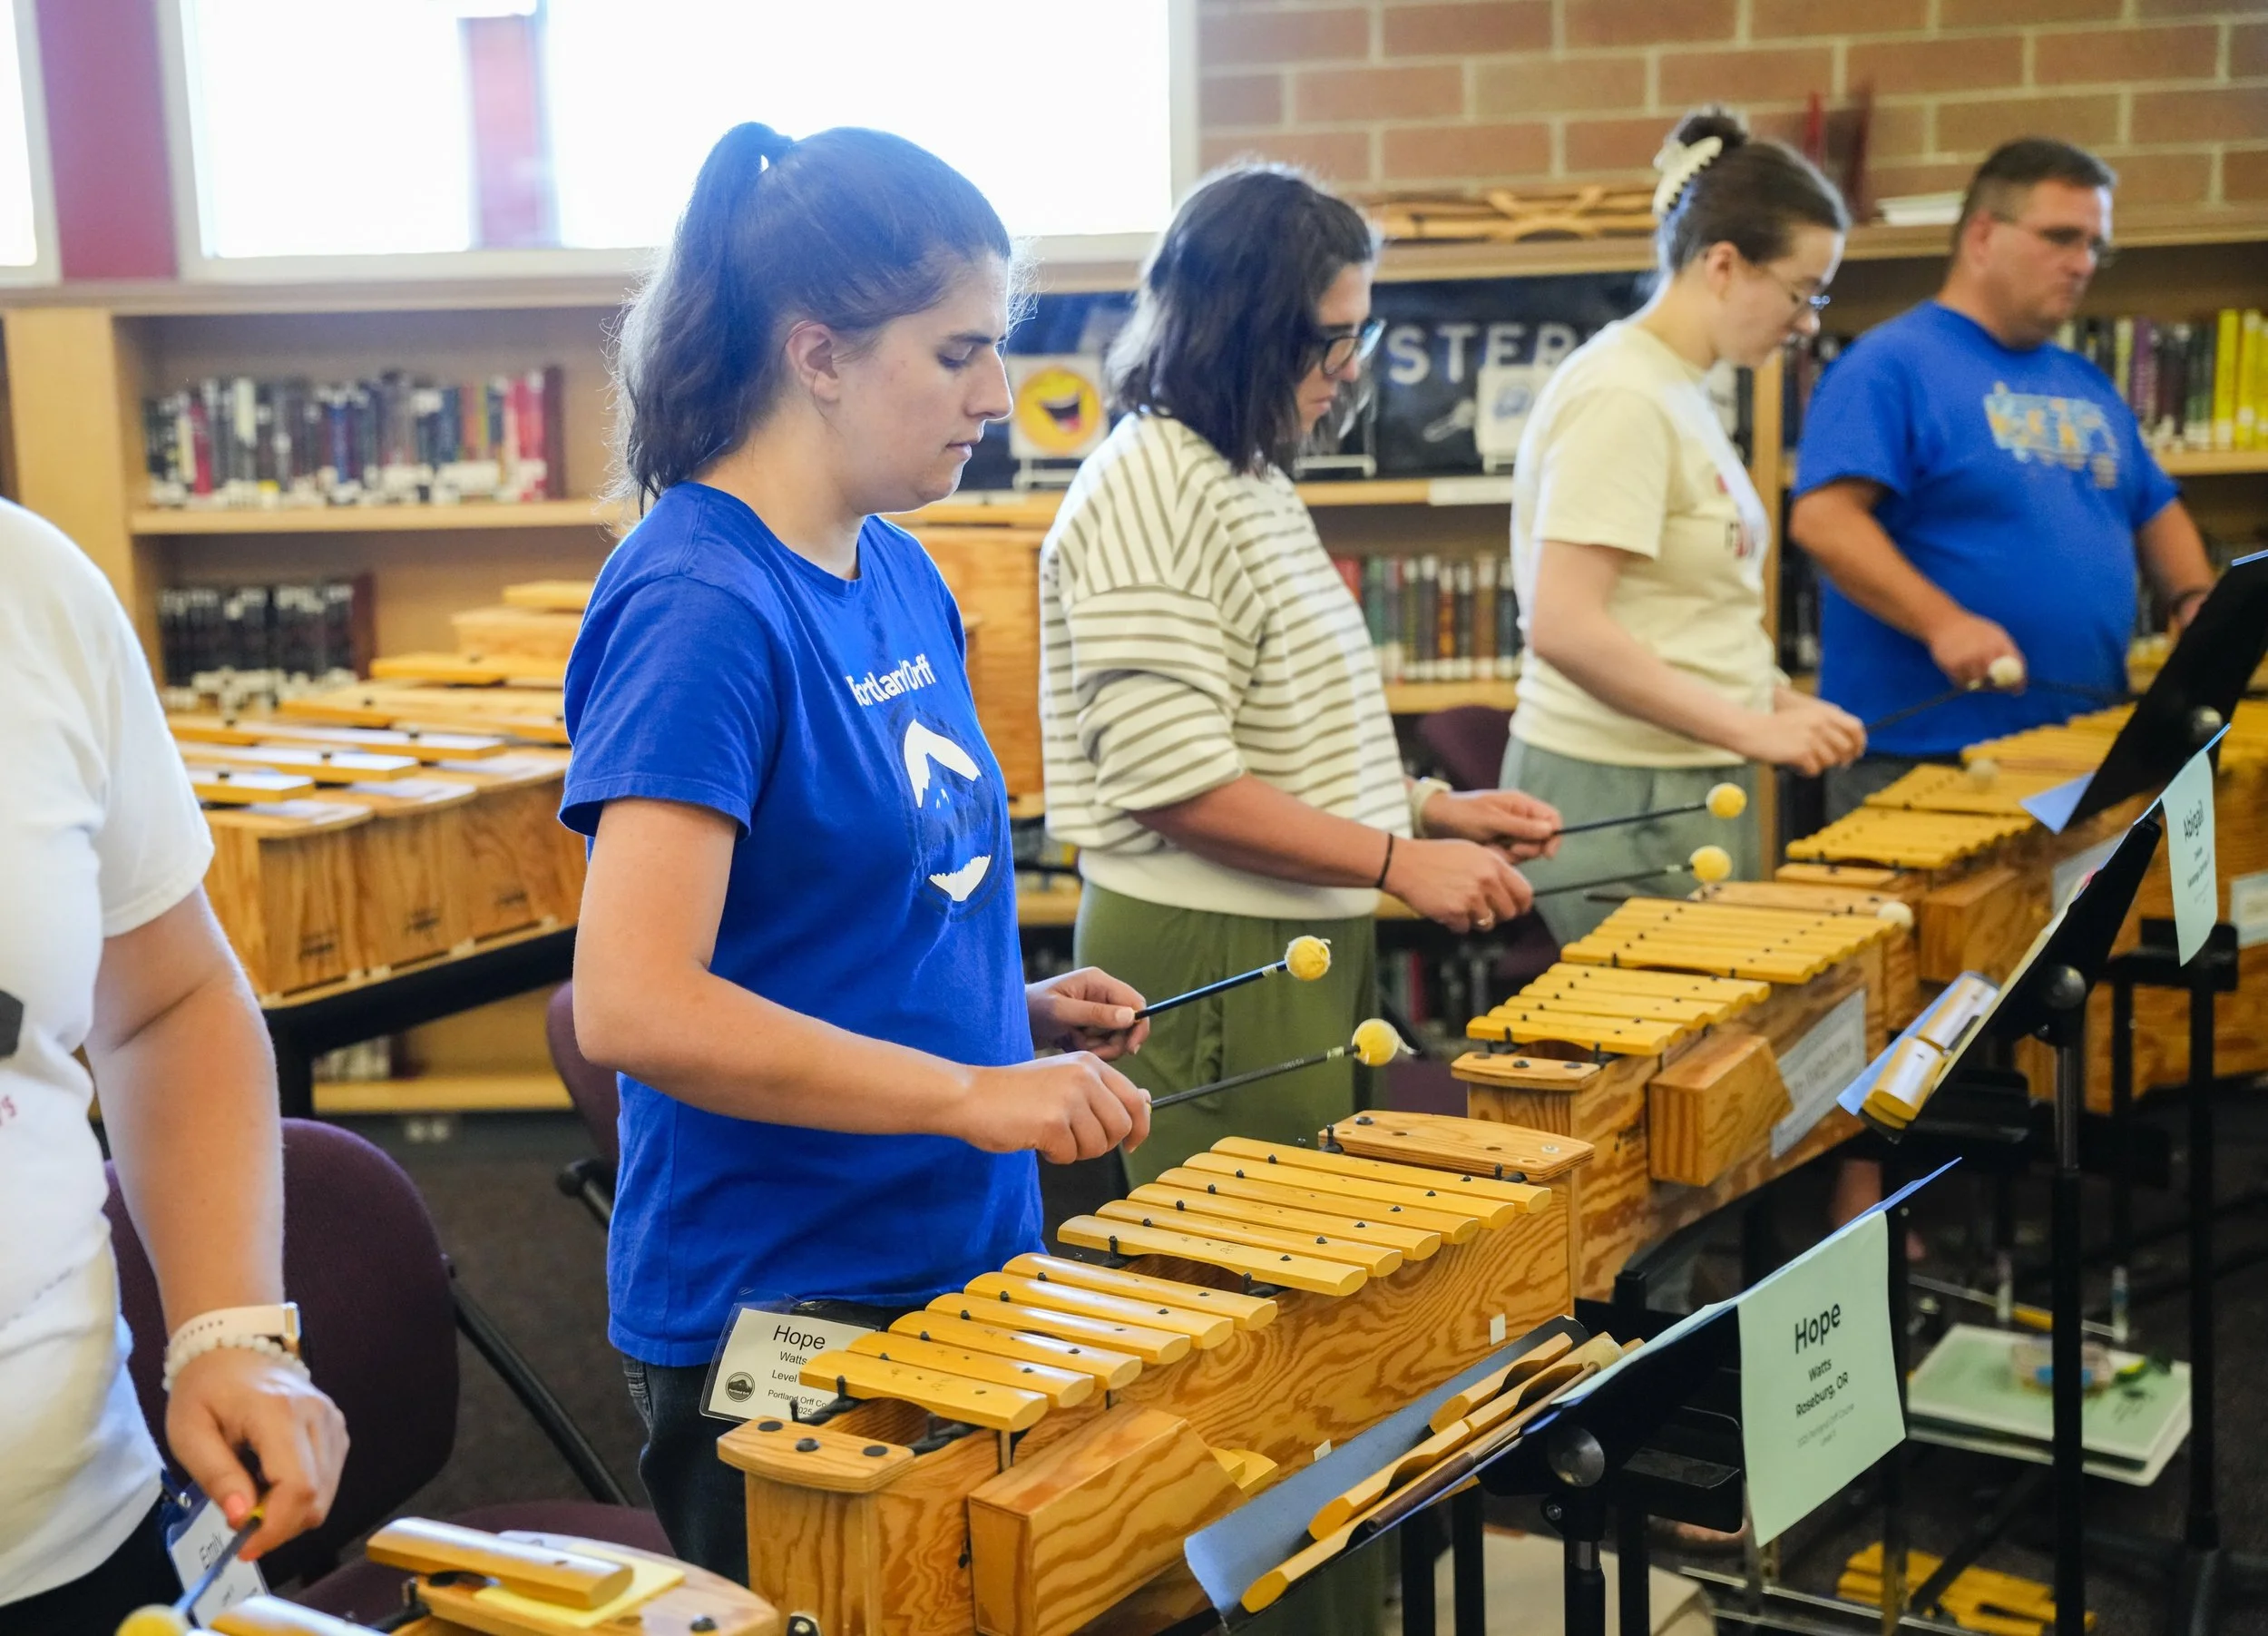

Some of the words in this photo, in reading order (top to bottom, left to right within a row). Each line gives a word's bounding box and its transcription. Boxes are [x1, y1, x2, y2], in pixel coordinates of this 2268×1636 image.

[773, 1324, 826, 1350] Hope
[1795, 1303, 1841, 1355] Hope
[780, 1351, 808, 1365] Watts
[772, 1369, 797, 1383] Level
[1808, 1358, 1833, 1382] Watts
[1836, 1371, 1849, 1389] OR
[800, 1396, 814, 1406] Orff
[798, 1406, 813, 1416] 025
